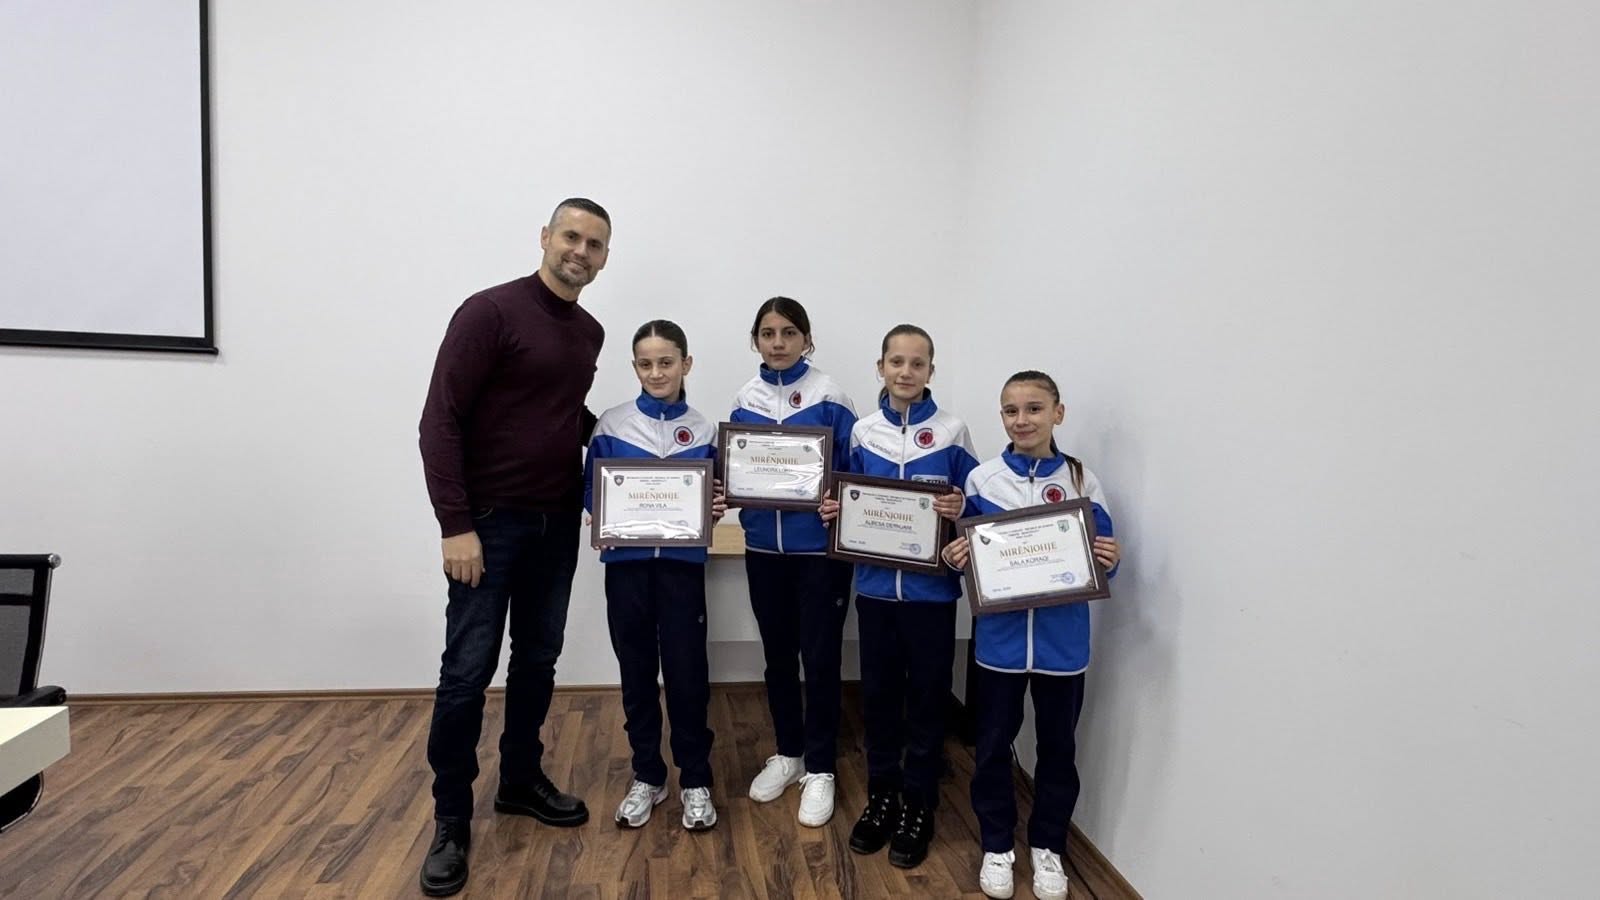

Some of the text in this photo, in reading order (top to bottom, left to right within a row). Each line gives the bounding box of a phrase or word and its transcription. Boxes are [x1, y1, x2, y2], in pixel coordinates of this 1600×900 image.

[750, 455, 799, 465] MIRËNJOHJE
[628, 490, 680, 501] MIRËNJOHJE
[863, 508, 913, 522] MIRËNJOHJE
[999, 541, 1058, 559] MIRËNJOHJE
